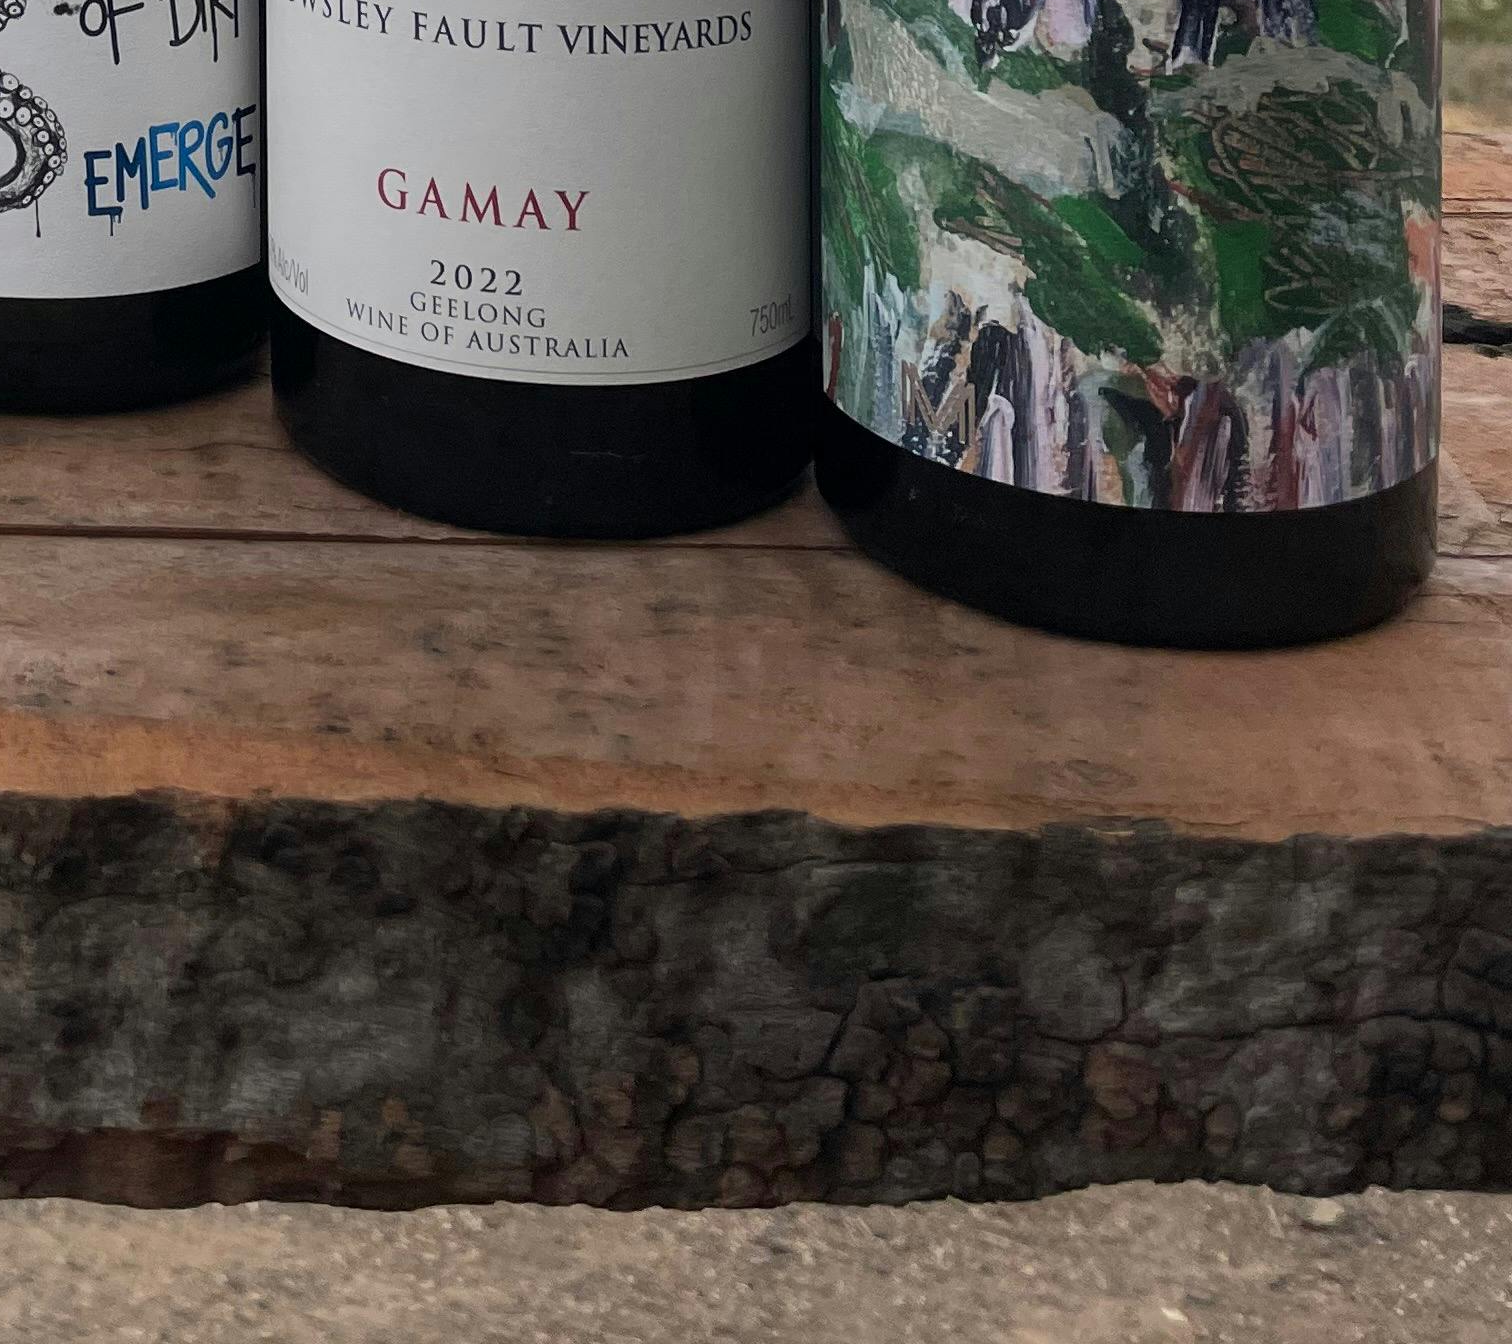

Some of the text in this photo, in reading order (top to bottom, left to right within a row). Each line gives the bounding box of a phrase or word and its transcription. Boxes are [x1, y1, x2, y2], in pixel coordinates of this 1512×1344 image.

[411, 10, 543, 53] FAULT
[557, 10, 752, 54] VINEYARDS
[84, 104, 256, 232] EMERGE
[377, 168, 590, 231] GAMAY
[430, 260, 523, 296] 2022
[346, 297, 629, 358] WINE OF AUSTRALIA
[410, 291, 546, 328] GEELONG
